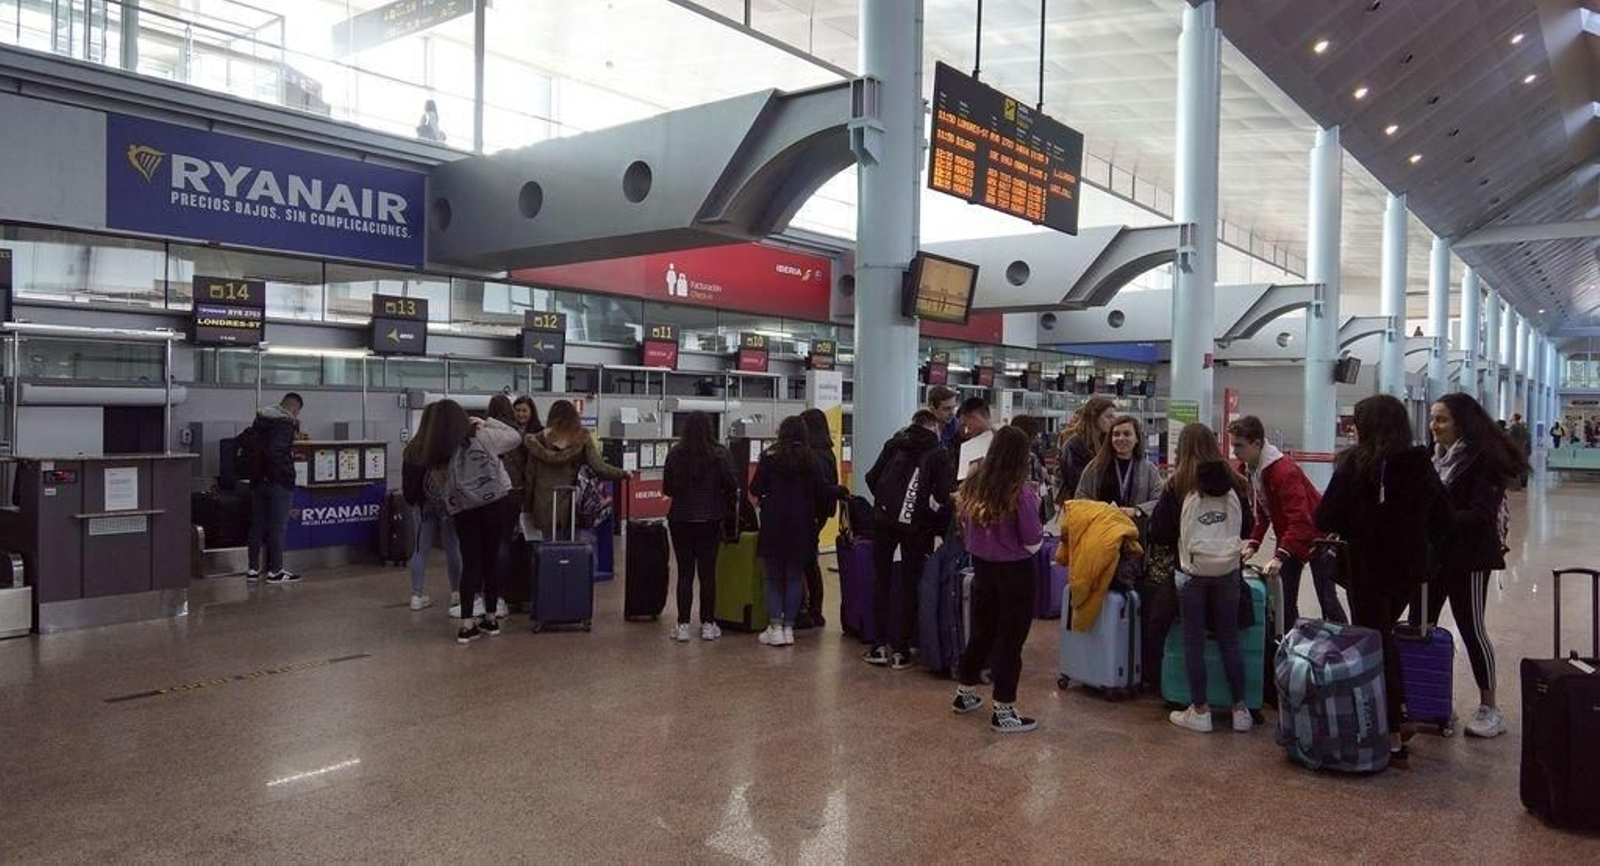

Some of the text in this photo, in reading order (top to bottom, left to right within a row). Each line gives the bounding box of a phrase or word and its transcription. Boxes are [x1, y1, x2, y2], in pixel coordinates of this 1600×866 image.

[171, 153, 408, 225] RYANAIR
[170, 191, 412, 239] PRECIOS BAJOS. SIN COMPLICACIONES.
[775, 264, 802, 276] IBERIA
[225, 282, 250, 301] 14
[399, 300, 416, 316] 13
[543, 314, 557, 329] 12
[660, 326, 671, 339] 11
[754, 335, 765, 348] 10
[635, 490, 662, 500] IBERIA
[902, 473, 921, 520] adidas
[302, 503, 381, 521] RYANAIR
